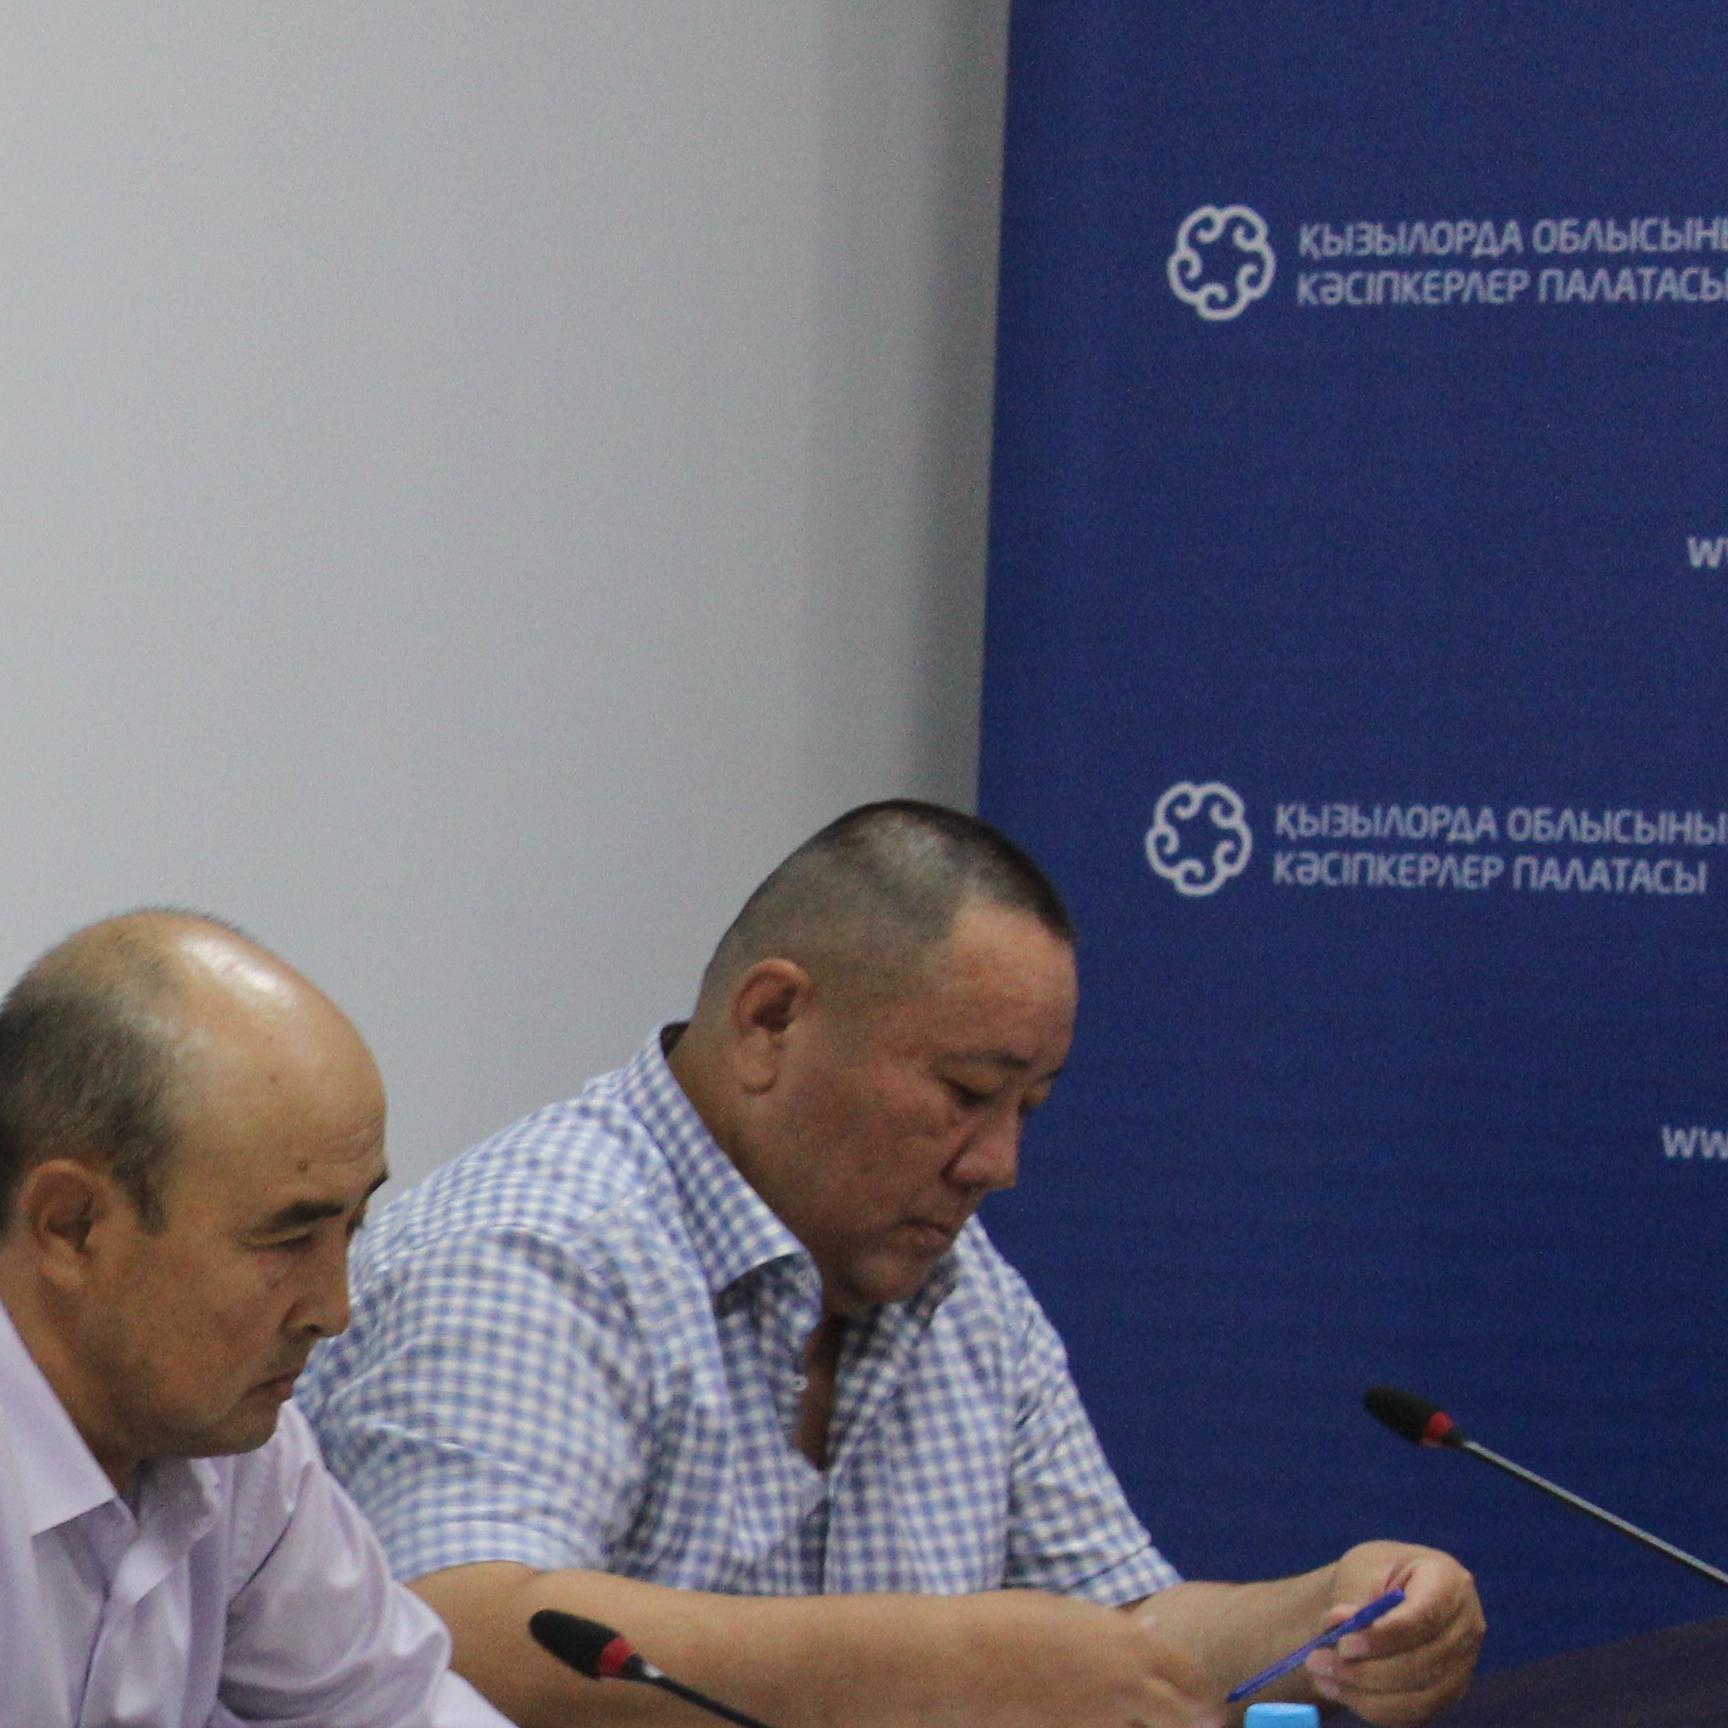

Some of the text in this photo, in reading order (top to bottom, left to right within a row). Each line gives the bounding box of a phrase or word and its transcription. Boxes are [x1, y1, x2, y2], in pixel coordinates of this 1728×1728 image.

[1298, 219, 1525, 260] ҚЫЗЫЛОРДА
[1274, 803, 1498, 844] ҚЫЗЫЛОРДА
[1512, 856, 1708, 895] ПАЛАТАСЫ
